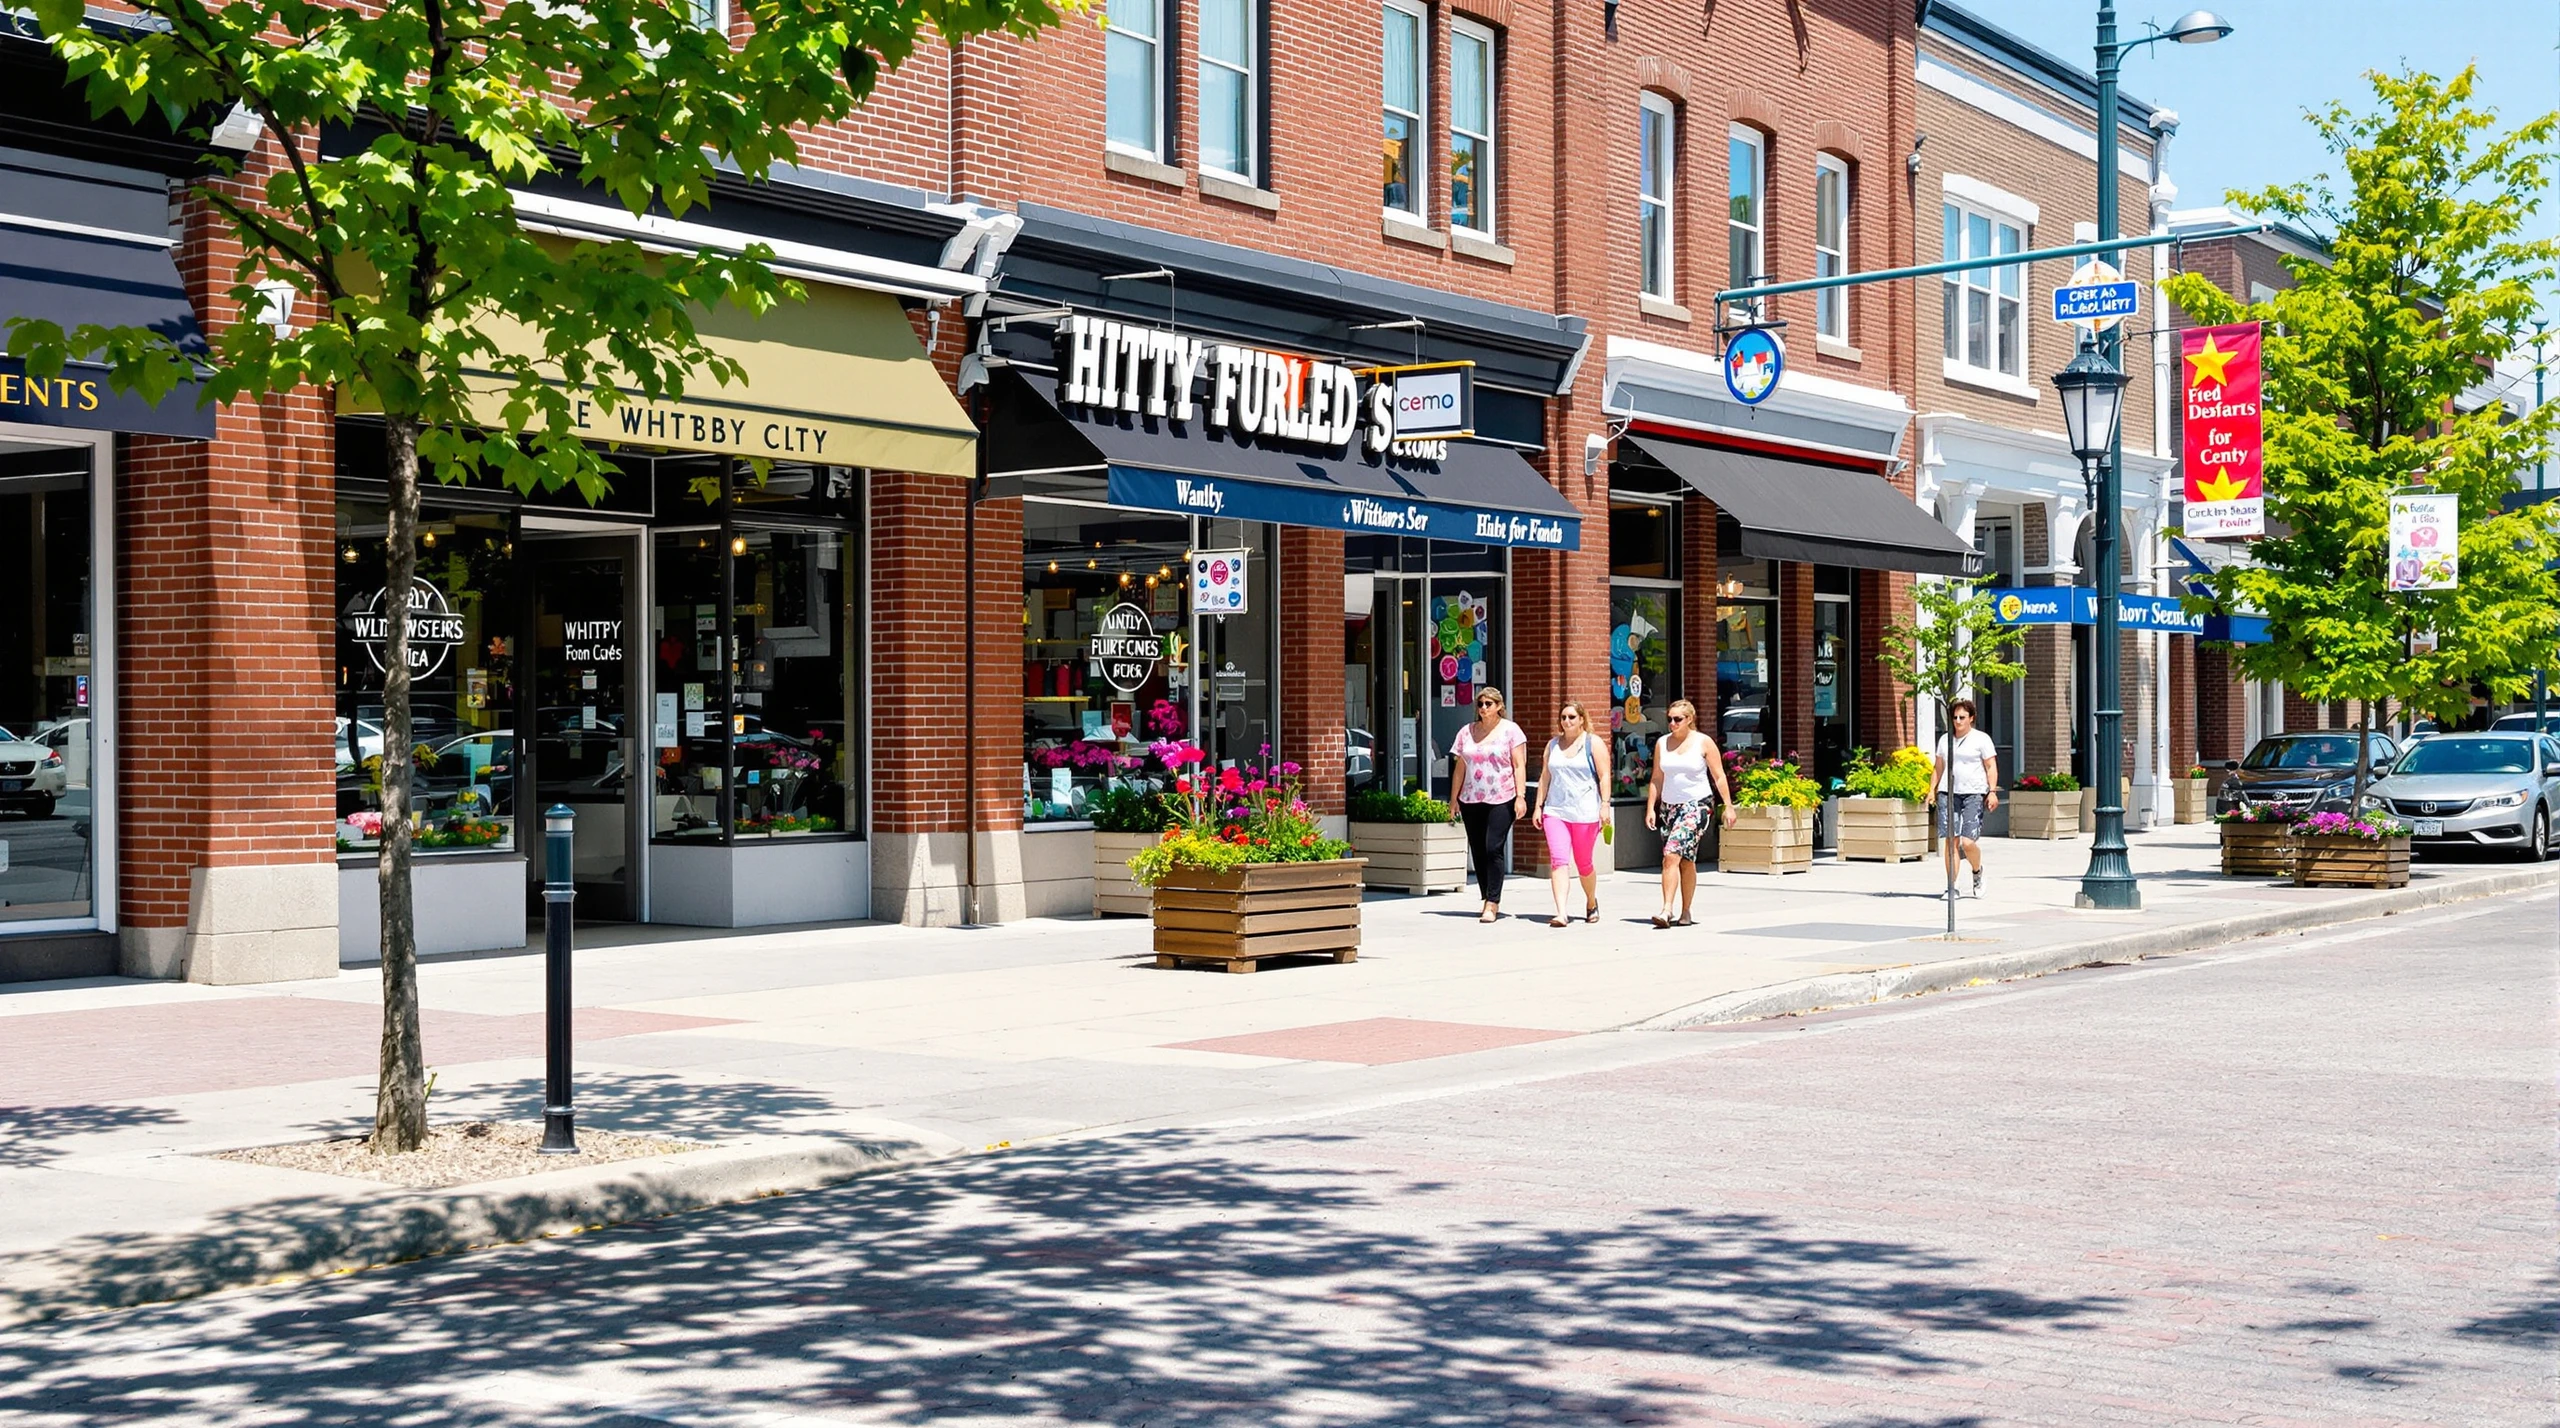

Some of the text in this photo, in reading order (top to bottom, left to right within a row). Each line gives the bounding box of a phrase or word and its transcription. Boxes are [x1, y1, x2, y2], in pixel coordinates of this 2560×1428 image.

[0, 373, 99, 411] ENTS
[1064, 315, 1202, 421] HITTY
[1210, 345, 1358, 445] FURLED
[1399, 393, 1454, 412] cemo
[2208, 427, 2233, 446] for
[1507, 516, 1528, 544] for
